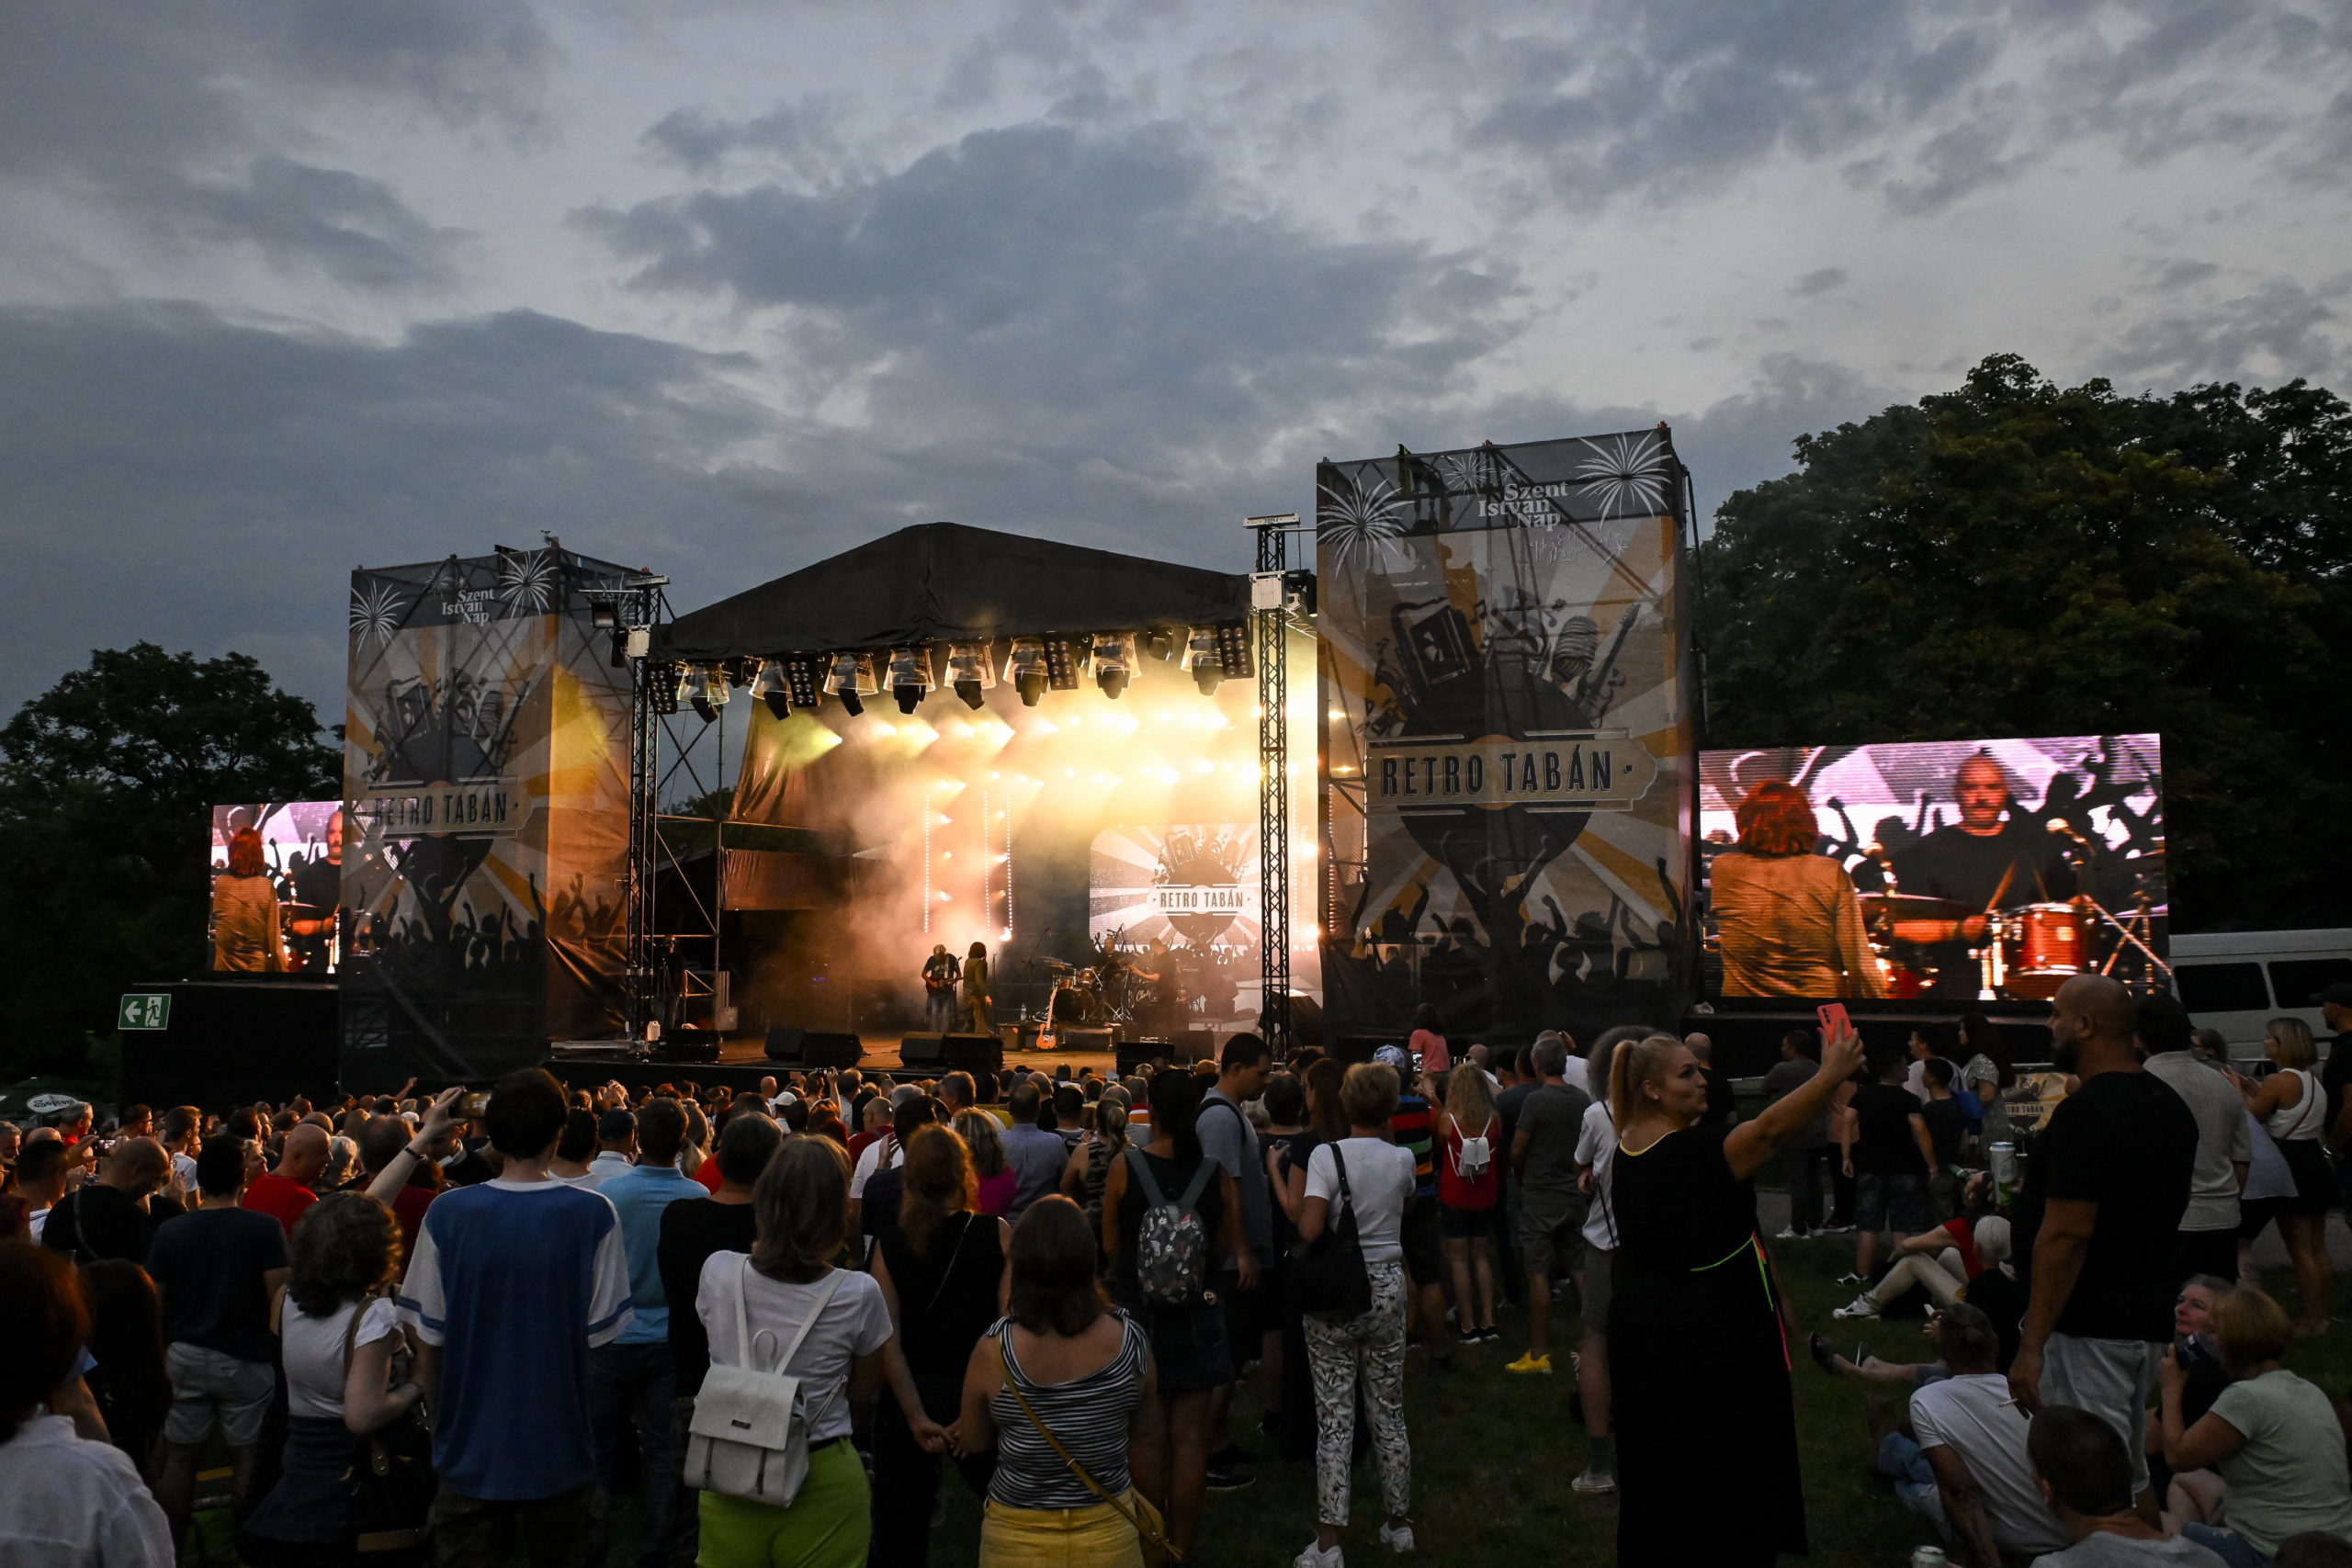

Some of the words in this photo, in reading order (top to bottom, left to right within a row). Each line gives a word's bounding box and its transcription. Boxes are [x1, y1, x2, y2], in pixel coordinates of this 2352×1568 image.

[1504, 481, 1569, 502] Szent
[1516, 513, 1561, 532] Nap
[457, 588, 495, 604] Szent
[462, 612, 490, 626] Nap
[1380, 754, 1485, 797] RETRO
[1500, 744, 1611, 793] TABÁN
[372, 795, 434, 827] RETRO
[443, 786, 506, 824] TABÁN
[1160, 892, 1198, 908] RETRO
[1204, 889, 1243, 908] TABÁN
